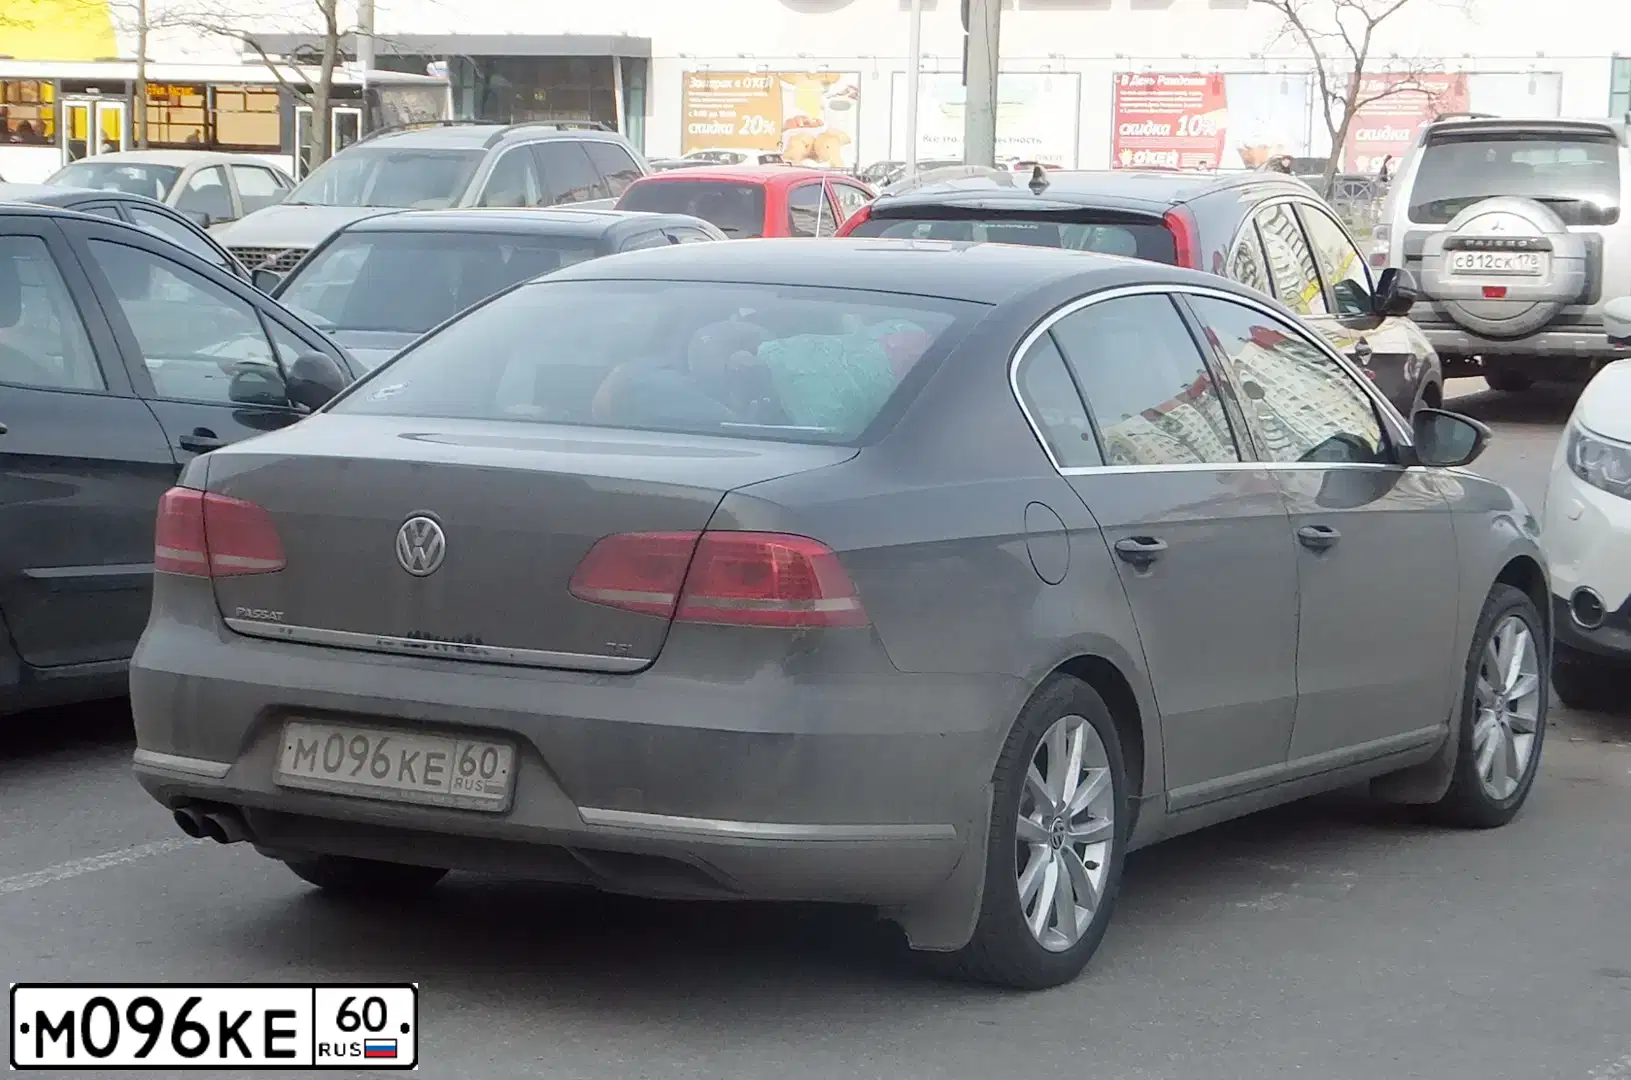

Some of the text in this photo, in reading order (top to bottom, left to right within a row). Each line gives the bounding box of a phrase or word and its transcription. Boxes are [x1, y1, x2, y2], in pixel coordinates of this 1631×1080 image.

[738, 115, 776, 136] 20%
[1119, 114, 1218, 137] скидка 10%
[1355, 125, 1412, 141] скидка
[235, 606, 285, 621] PASSAT
[458, 744, 499, 780] 60
[453, 777, 483, 792] RUS
